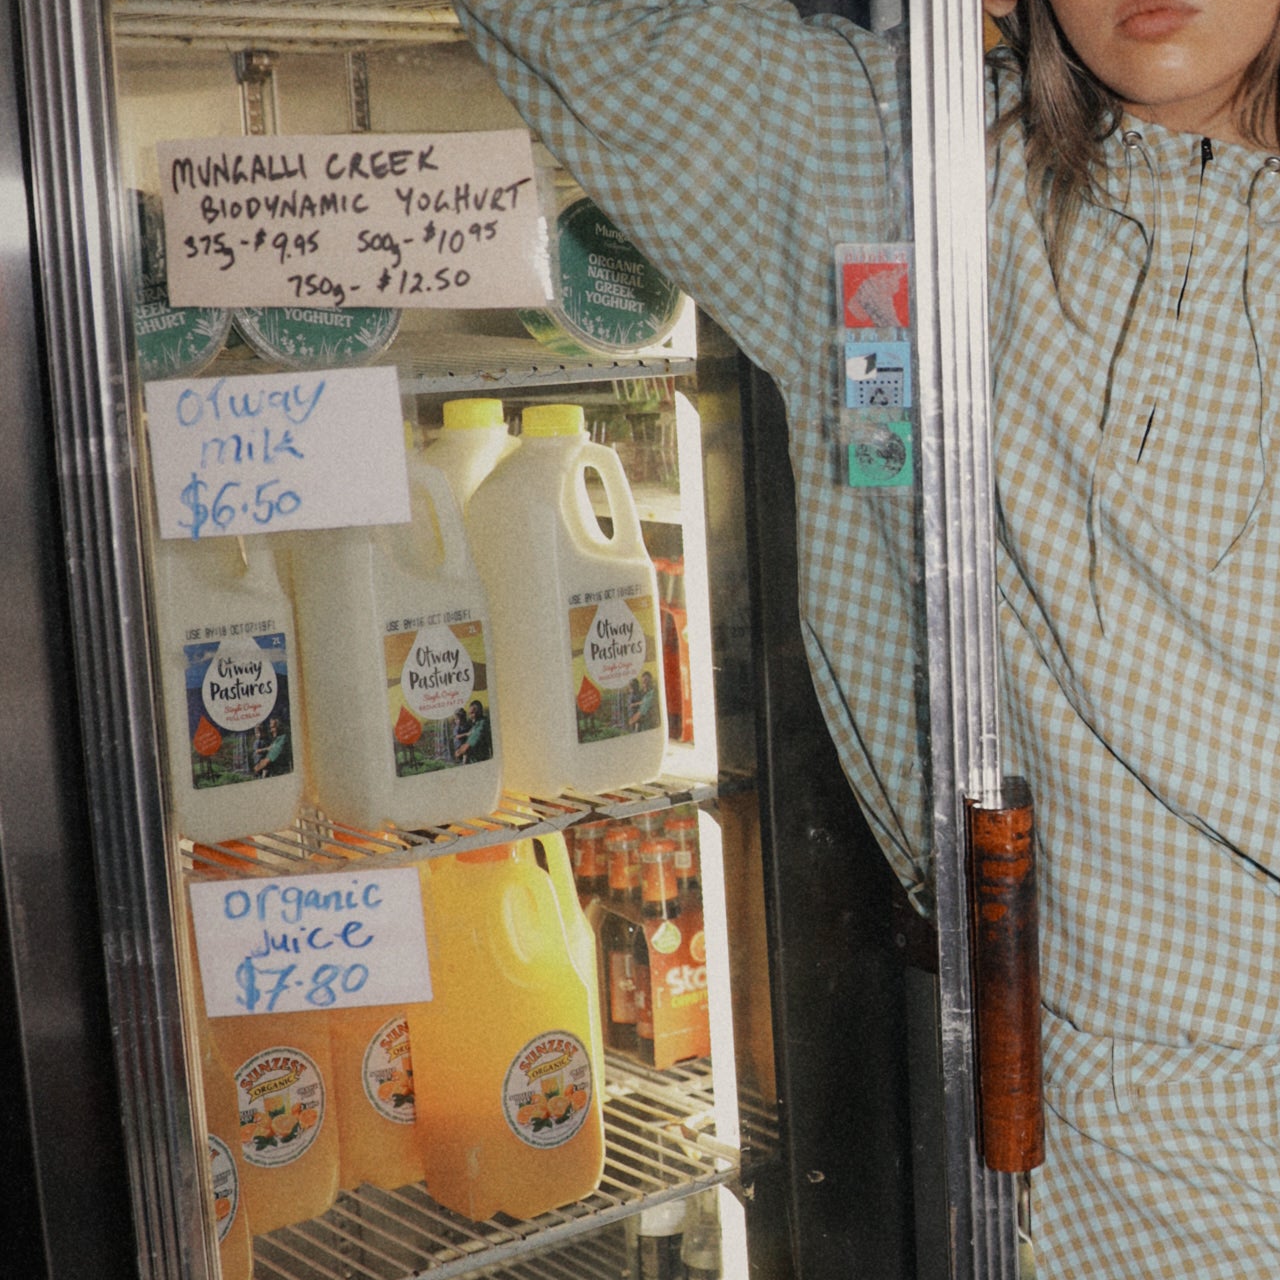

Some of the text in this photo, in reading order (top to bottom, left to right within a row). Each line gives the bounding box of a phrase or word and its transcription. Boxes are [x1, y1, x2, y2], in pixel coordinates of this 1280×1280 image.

[171, 144, 440, 194] MUNGALLI CREEK
[200, 177, 533, 224] BIODYNAMIC YOGHURT
[588, 252, 645, 276] ORGANIC
[586, 266, 645, 289] NATURAL
[593, 280, 636, 299] GREEK
[584, 290, 645, 313] YOGHURT
[283, 307, 355, 328] YOGHURT
[177, 472, 301, 541] $6.50
[185, 629, 201, 640] USE
[596, 618, 634, 641] Otway
[415, 646, 460, 670] Otway
[590, 639, 643, 661] Pastures
[210, 678, 273, 702] Pastures
[409, 667, 471, 690] Pastures
[223, 879, 383, 924] organic
[234, 955, 370, 1012] $7.80
[520, 1039, 579, 1073] SUNZEST
[239, 1057, 308, 1092] SUNZEST
[531, 1058, 568, 1079] ORGANIC
[253, 1077, 293, 1096] ORGANIC
